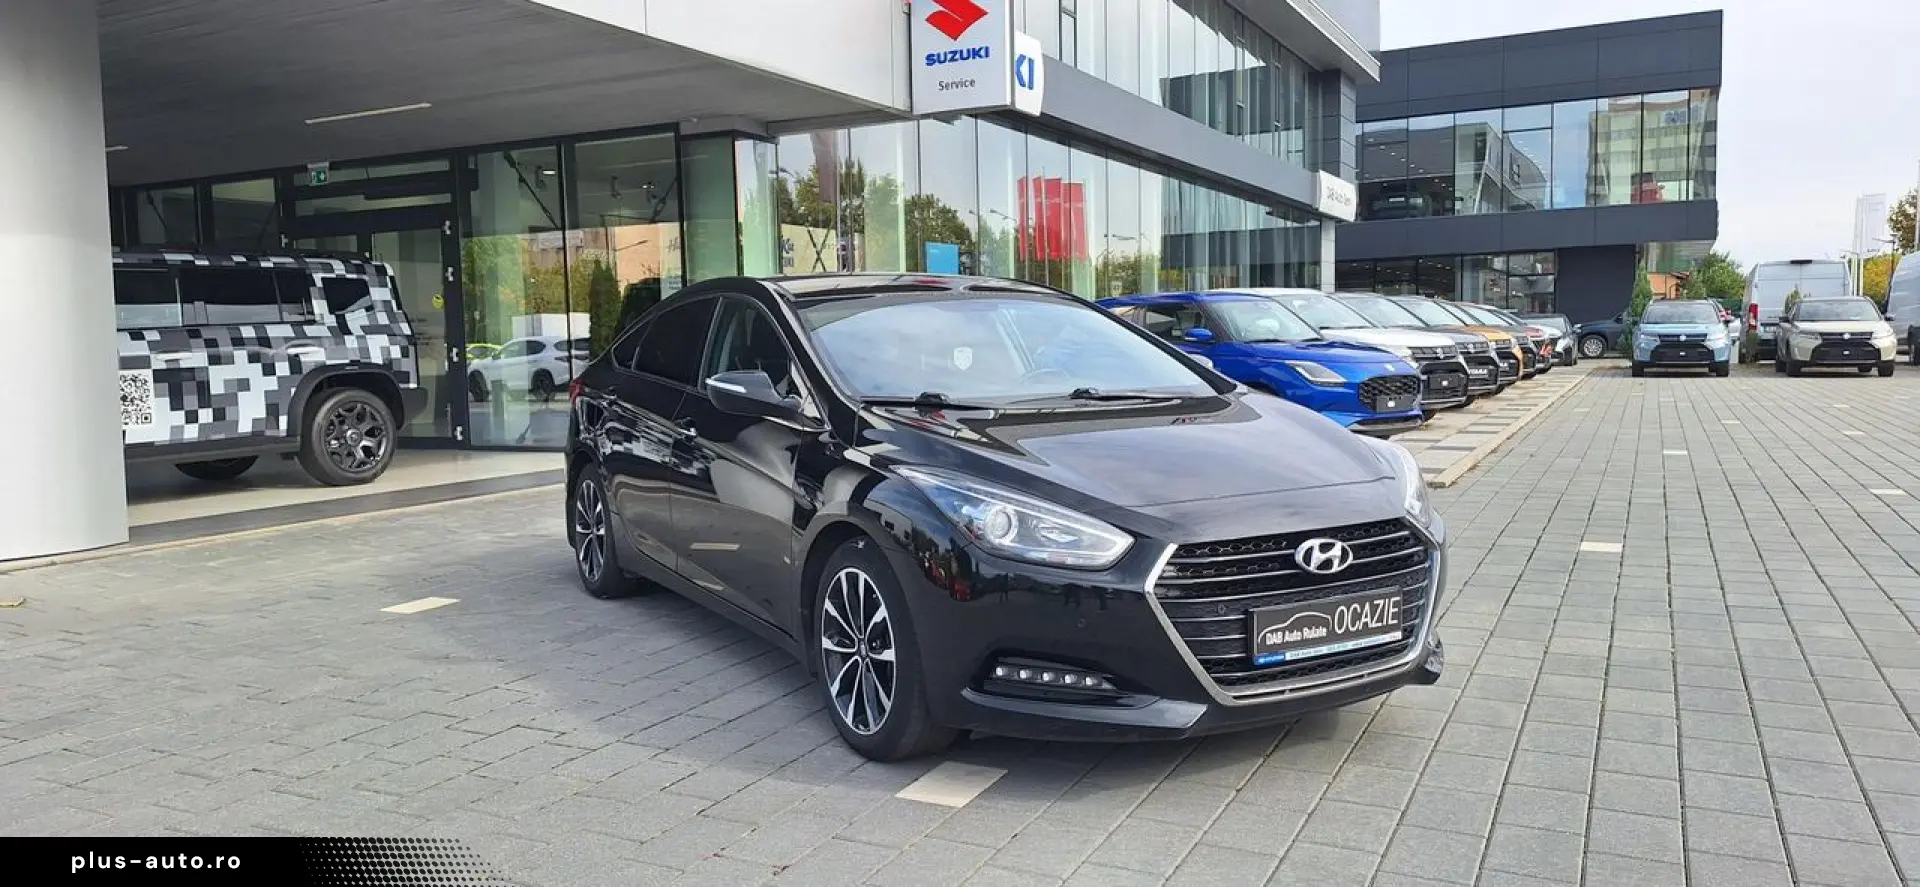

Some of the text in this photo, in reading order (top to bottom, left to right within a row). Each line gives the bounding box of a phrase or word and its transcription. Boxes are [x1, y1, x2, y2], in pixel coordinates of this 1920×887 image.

[925, 46, 990, 66] SUZUKI
[938, 78, 976, 91] Service
[1334, 596, 1400, 634] OCAZIE
[1265, 625, 1327, 645] DAB Auto Rulate
